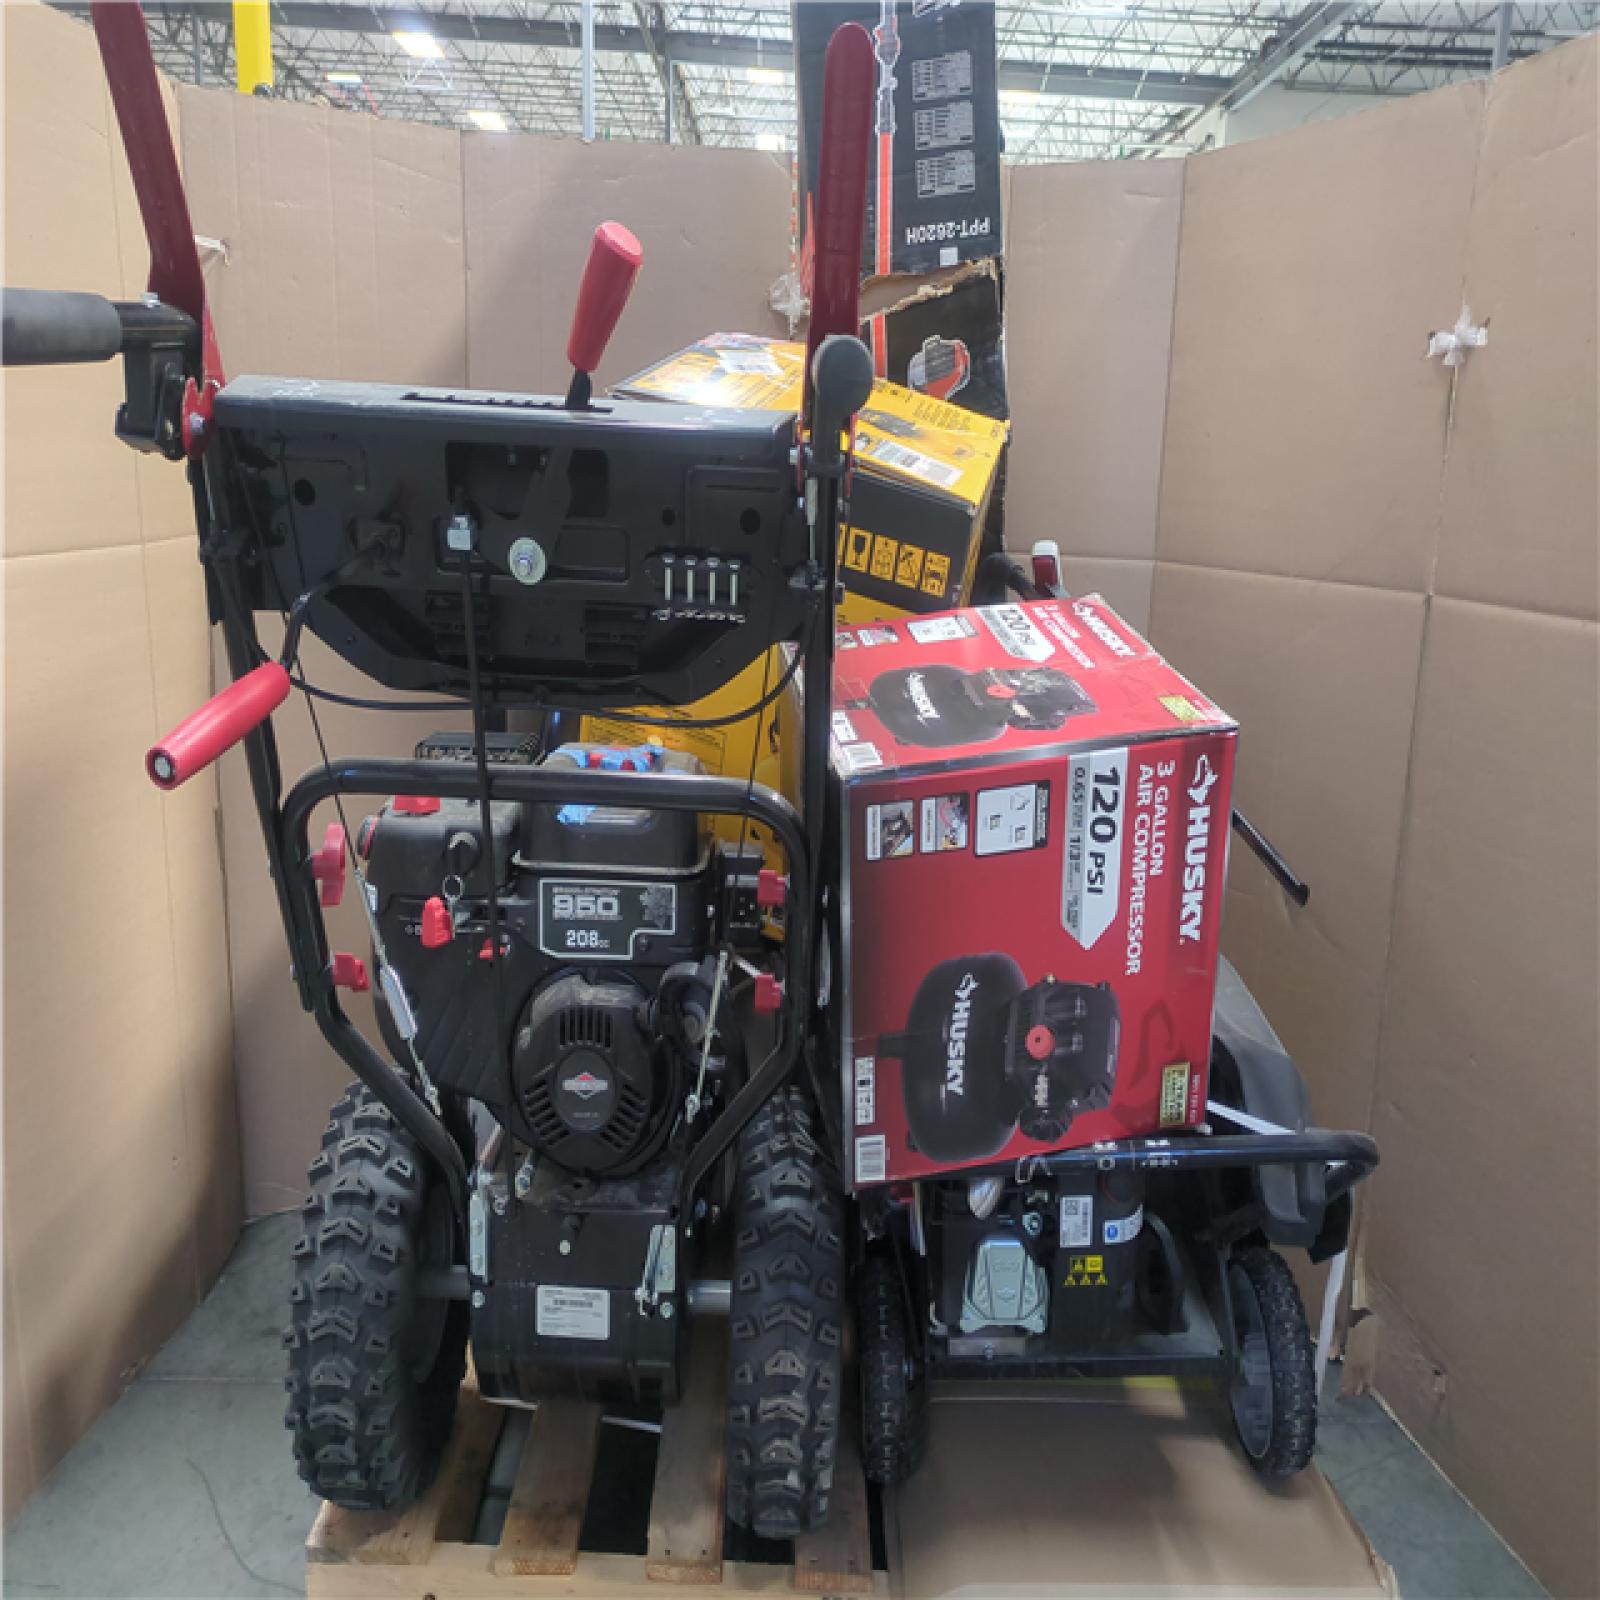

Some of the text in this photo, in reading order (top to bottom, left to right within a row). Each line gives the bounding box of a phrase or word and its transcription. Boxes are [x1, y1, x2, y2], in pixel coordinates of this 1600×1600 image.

[1087, 767, 1121, 895] 120 PSI
[1125, 764, 1154, 976] AIR COMPRESSOR
[1149, 759, 1176, 876] 3 GALLON
[1179, 804, 1211, 942] HUSKY
[946, 1000, 971, 1096] HUSKY
